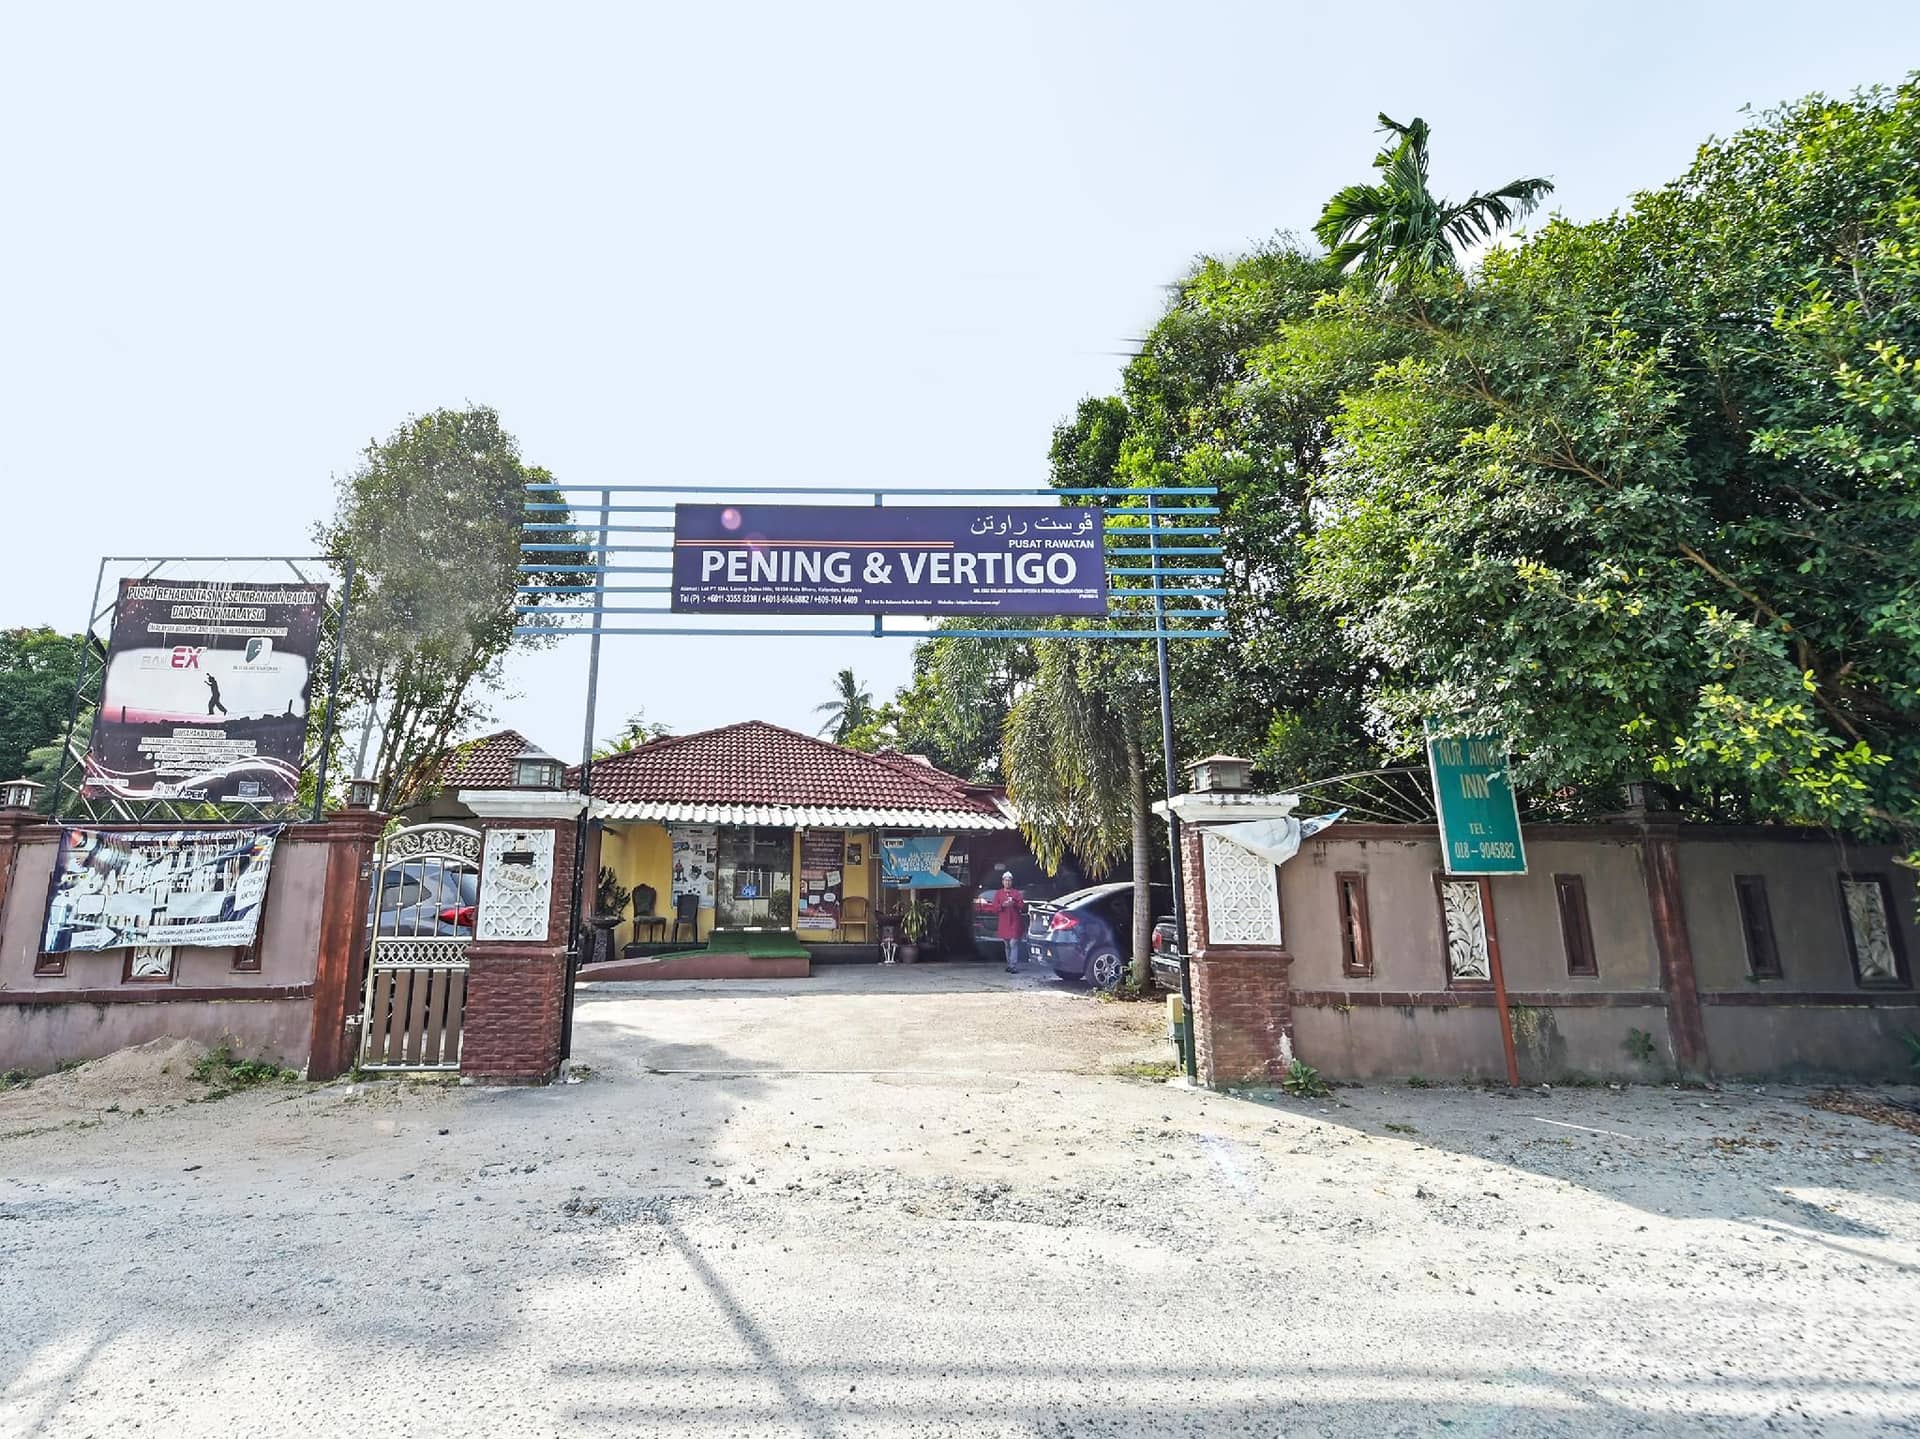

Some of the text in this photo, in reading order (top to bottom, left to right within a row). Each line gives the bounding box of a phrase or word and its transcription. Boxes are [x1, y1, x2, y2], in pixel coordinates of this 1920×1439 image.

[1009, 539, 1094, 549] PUSAT RAWATAN
[701, 550, 1077, 585] PENING & VERTIGO
[127, 586, 316, 605] PUSAT REHABILITASI KESEIMBANGAN BADAN
[171, 605, 267, 621] DAN STROK MALAYSIA
[171, 647, 202, 669] EX
[1439, 741, 1464, 766] NUR
[1460, 774, 1490, 799] INN
[1469, 823, 1485, 835] TEL
[1455, 842, 1469, 858] 018
[1479, 842, 1516, 859] 9045882
[500, 869, 531, 885] 1344
